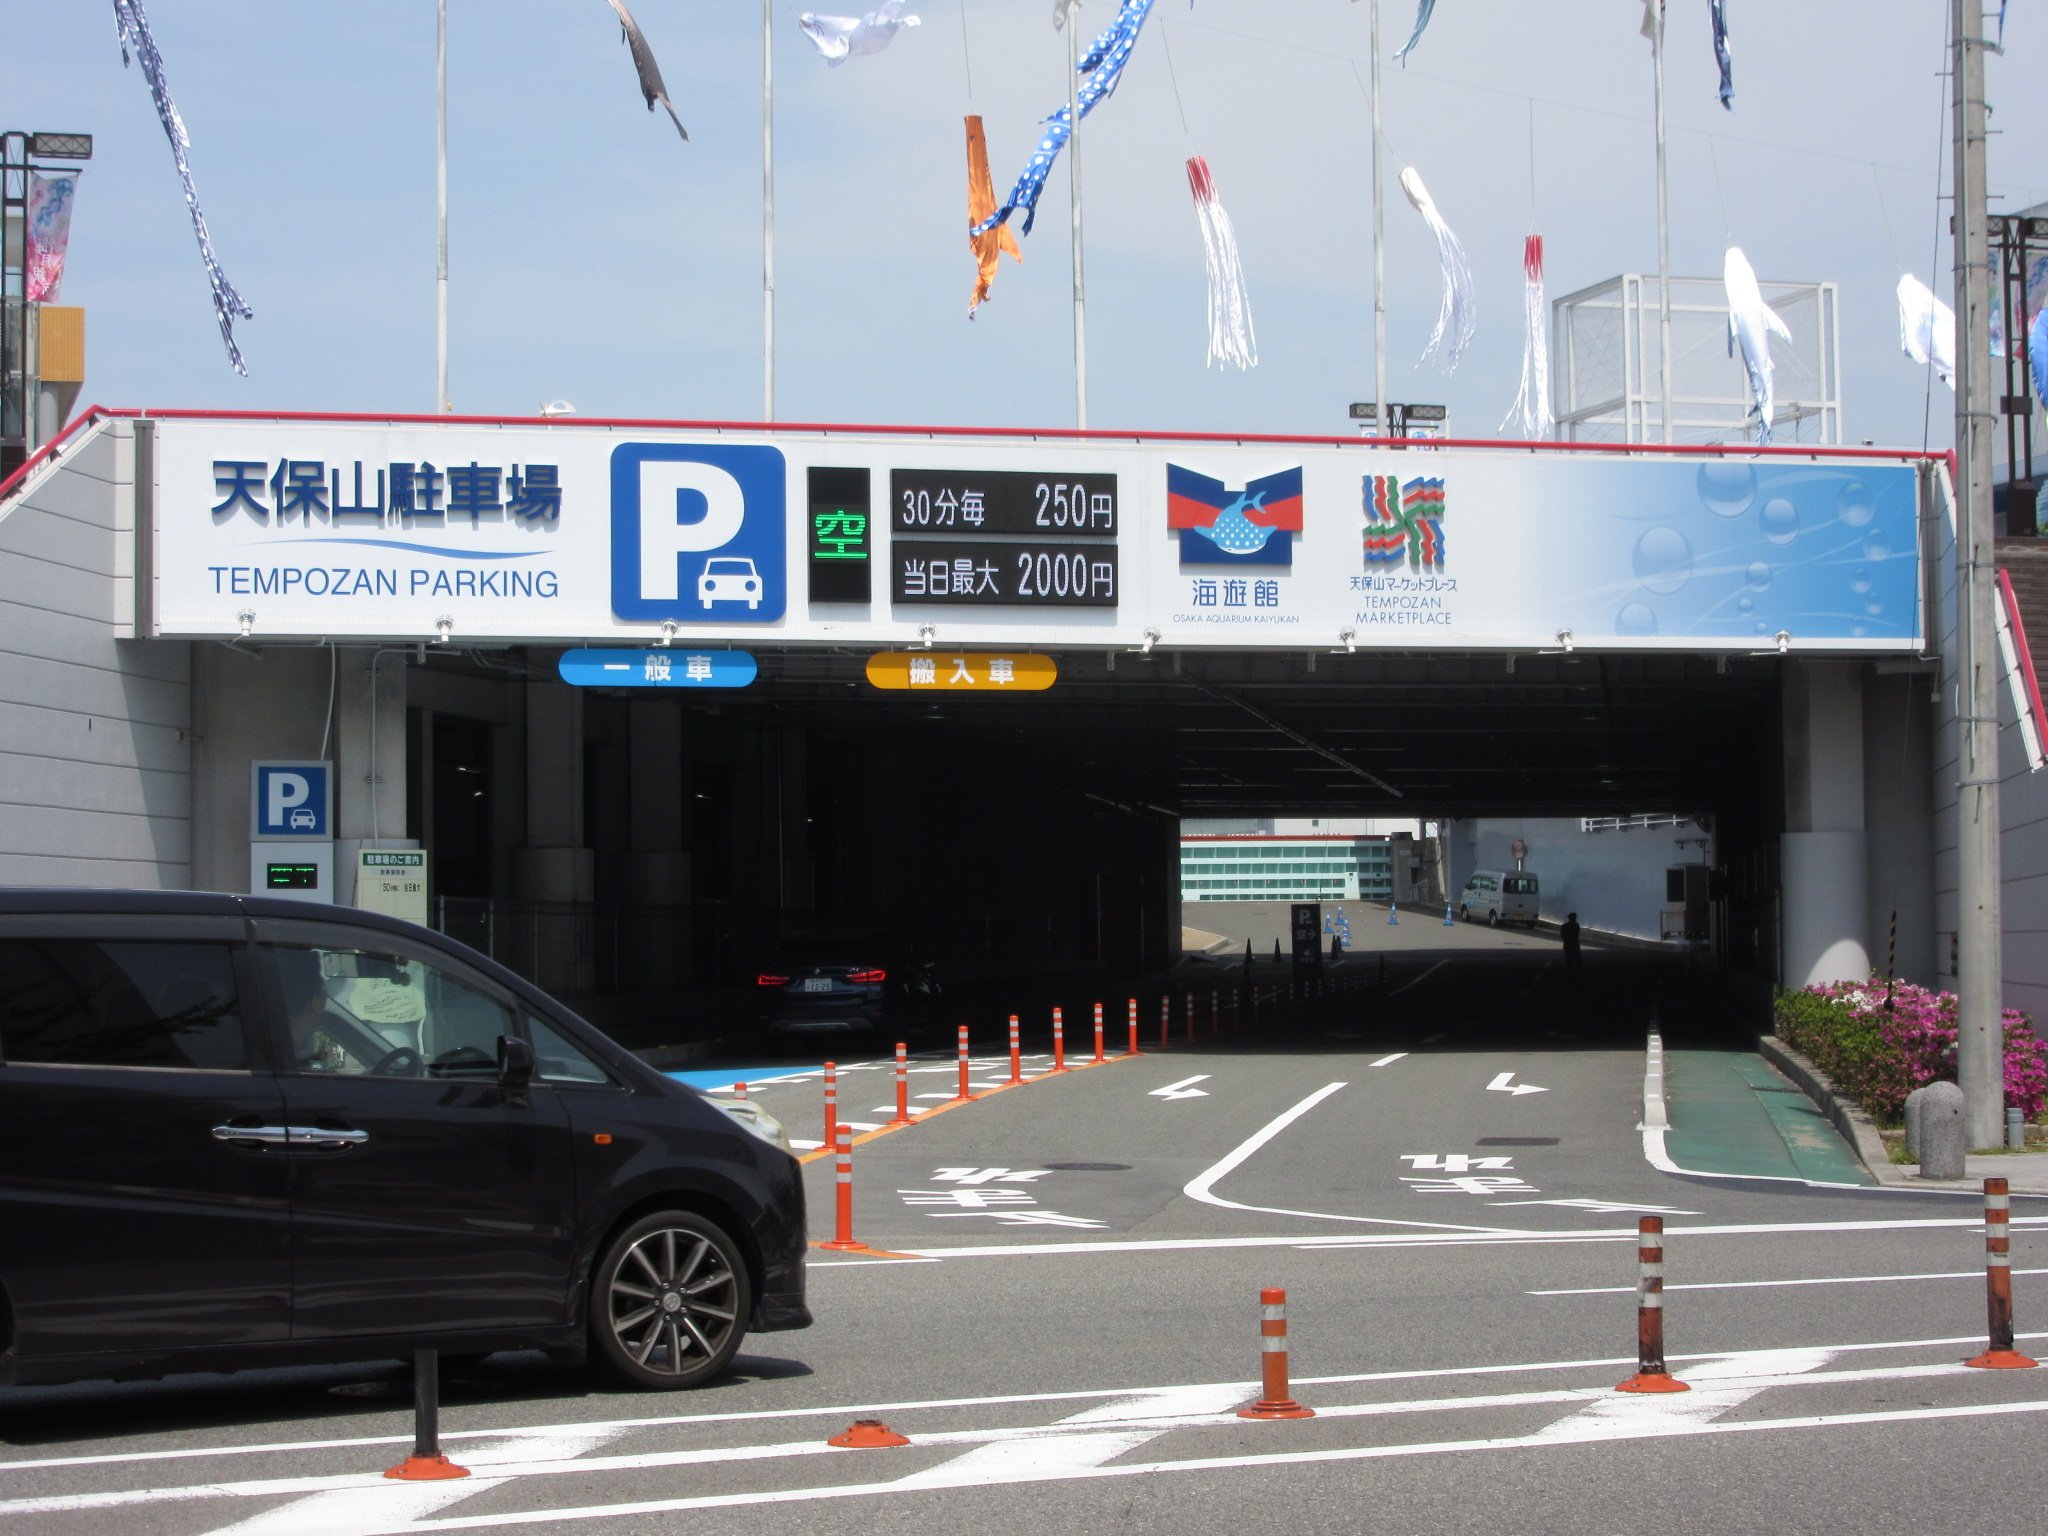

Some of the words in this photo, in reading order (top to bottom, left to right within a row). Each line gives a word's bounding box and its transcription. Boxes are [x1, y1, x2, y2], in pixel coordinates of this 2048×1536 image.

[211, 457, 563, 522] 天保山駐車場
[1036, 483, 1113, 529] 250円
[903, 488, 985, 527] 30分毎
[639, 460, 745, 600] P
[814, 510, 868, 559] 空
[208, 566, 397, 596] TEMPOZAN
[410, 569, 559, 598] PARKING
[904, 559, 999, 596] 当日最大
[1018, 552, 1113, 598] 2000円
[1350, 577, 1458, 592] 天保山マーケットプレース
[1192, 579, 1278, 607] 海遊館
[1365, 596, 1442, 609] TEMPOZAN
[1173, 614, 1203, 623] OSAKA
[1206, 614, 1252, 624] AQUARIUM
[1254, 615, 1300, 624] KAIYUKAN
[1356, 611, 1452, 625] MARKETPLACE
[603, 654, 713, 683] 一般車
[909, 657, 1015, 685] 搬入車
[268, 772, 310, 826] P
